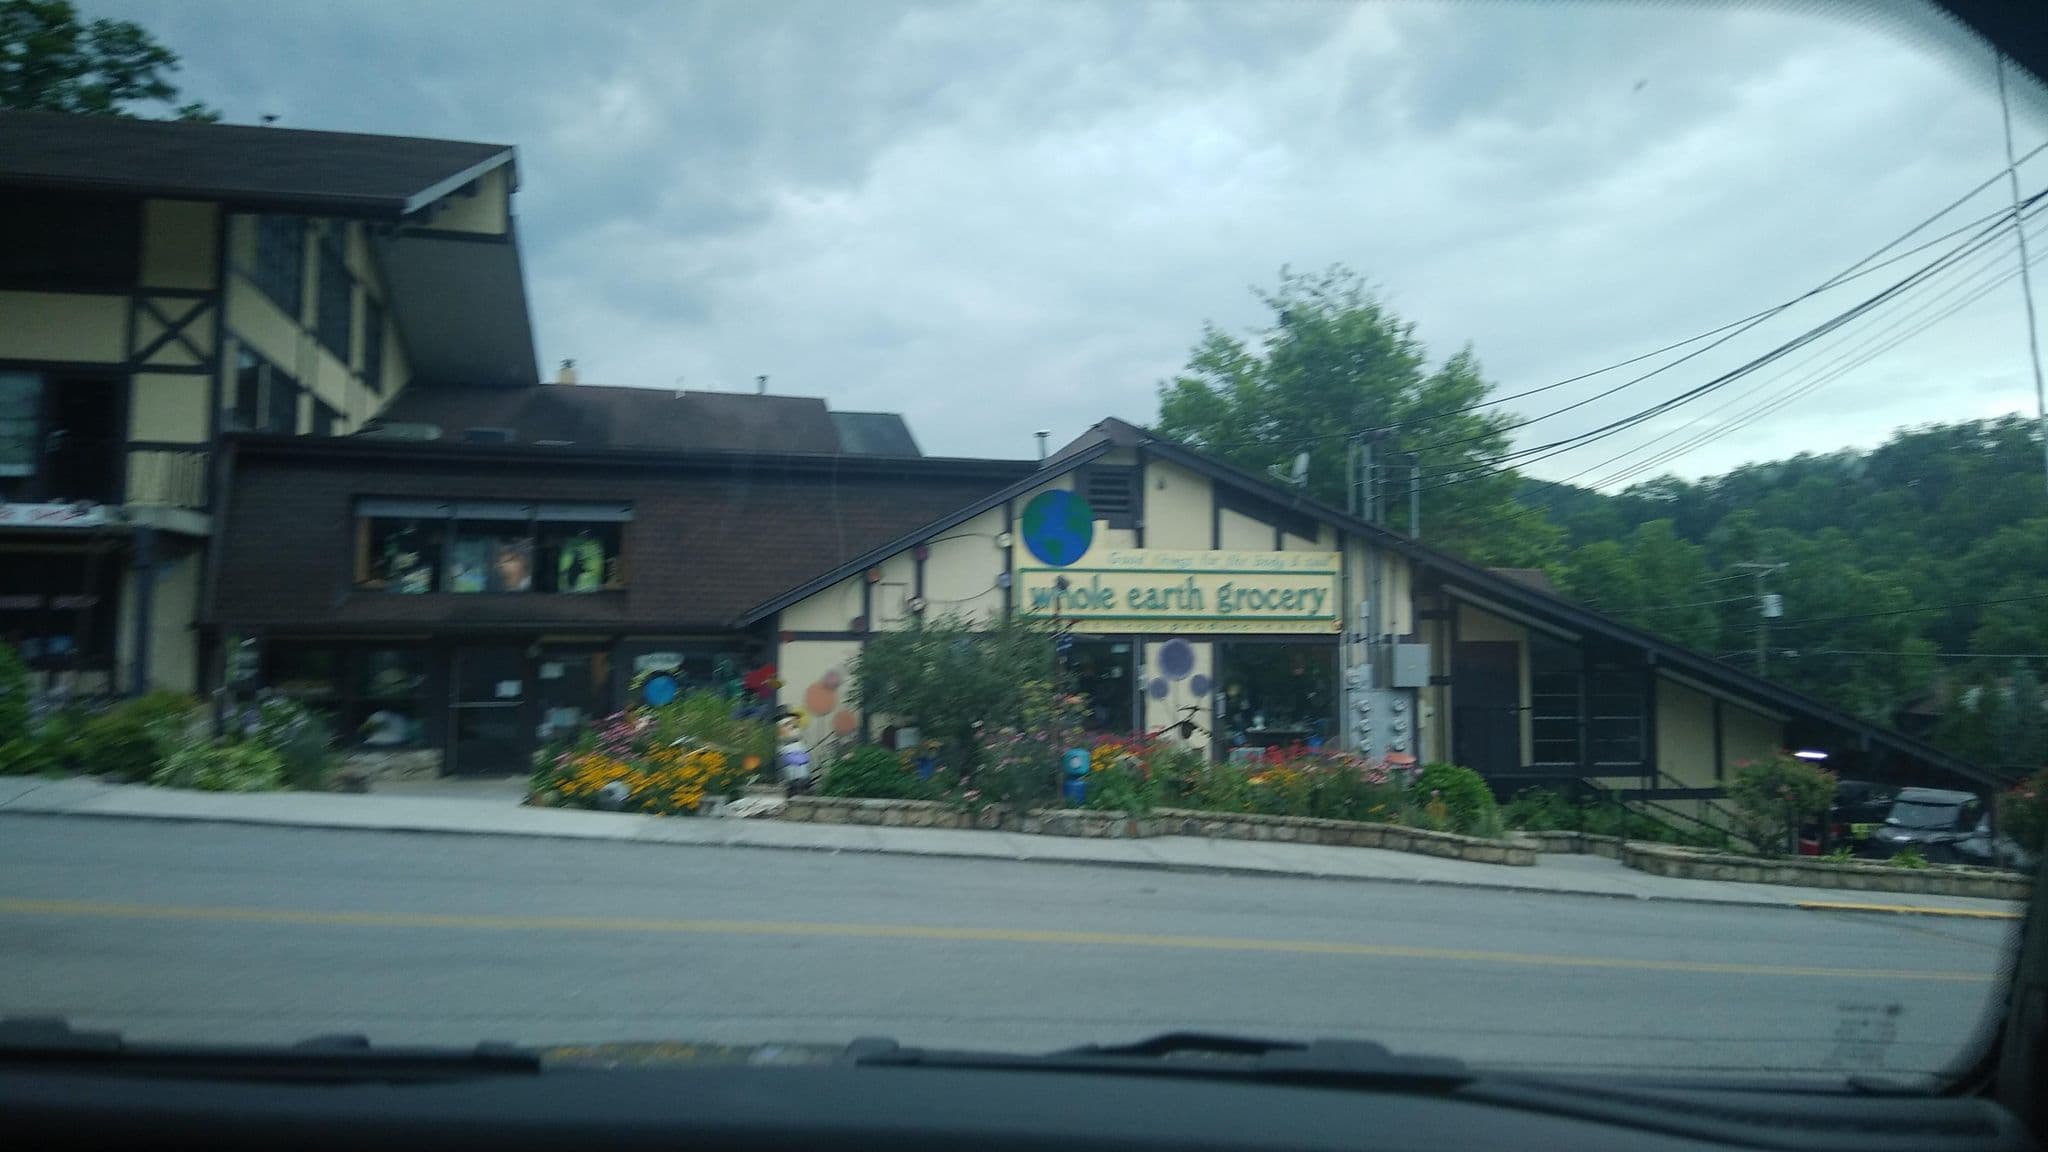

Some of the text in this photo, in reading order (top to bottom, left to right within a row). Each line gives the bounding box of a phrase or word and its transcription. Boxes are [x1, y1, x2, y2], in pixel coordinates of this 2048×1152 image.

[1030, 575, 1329, 616] whole earth grocery
